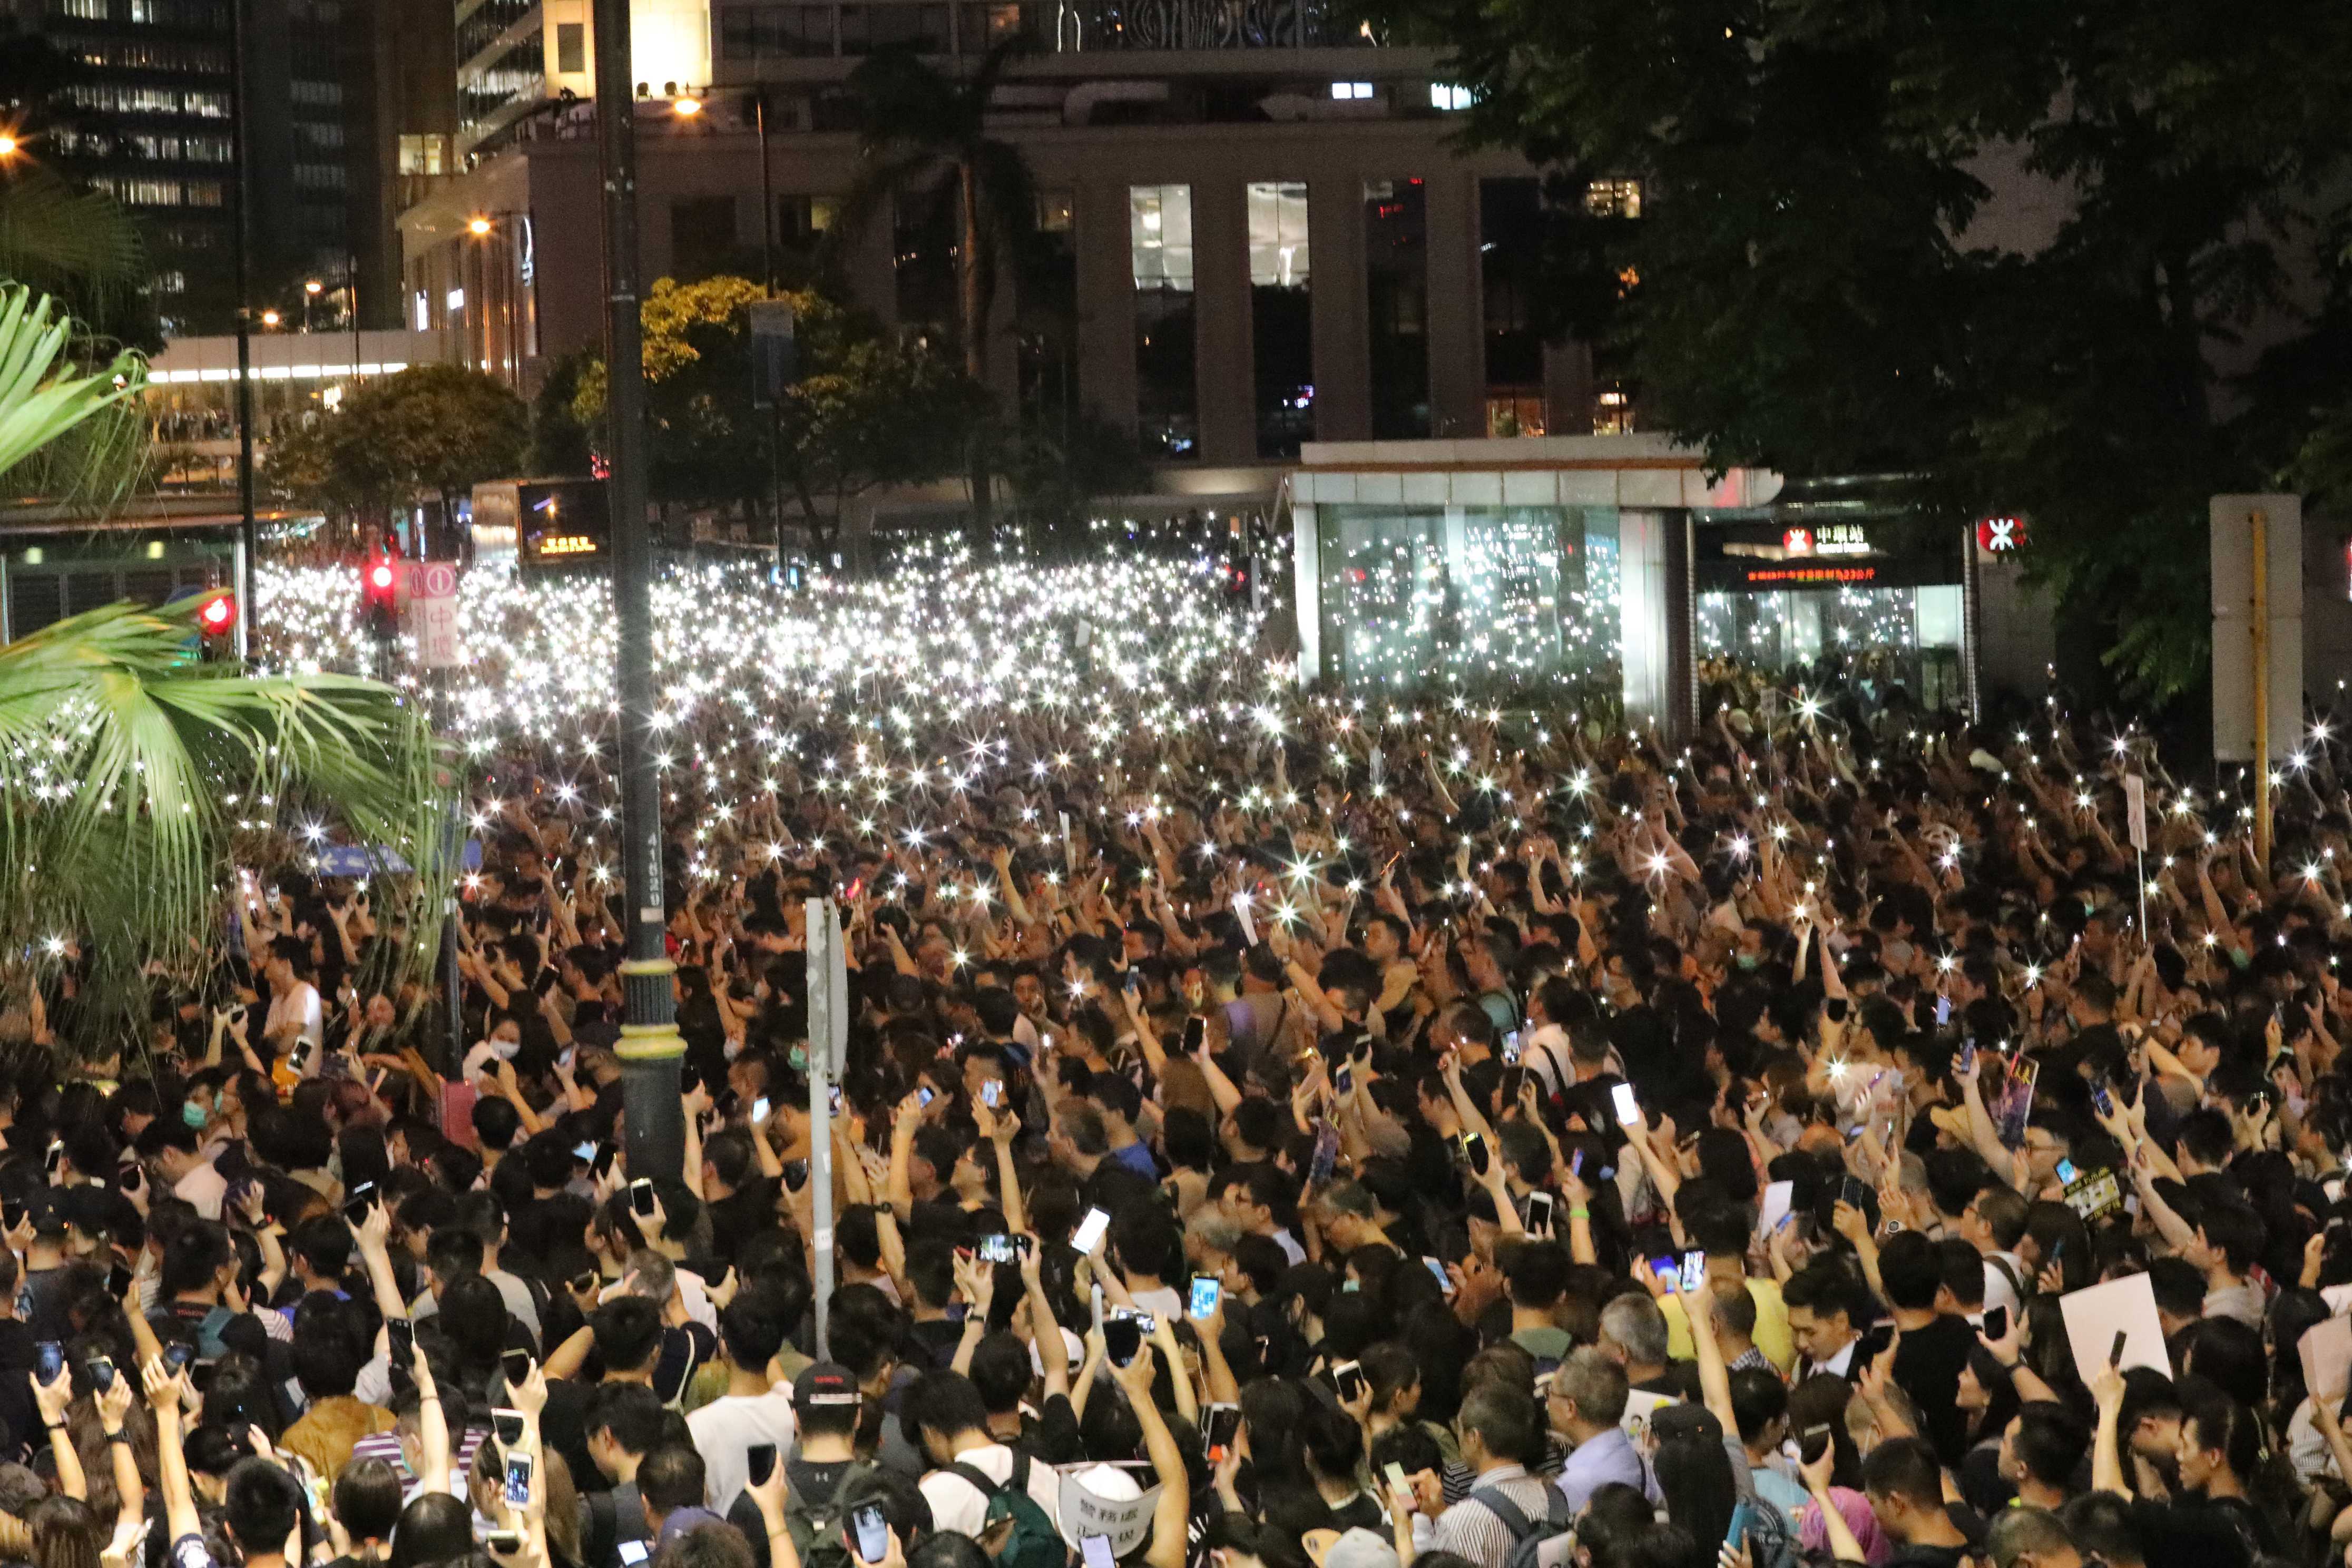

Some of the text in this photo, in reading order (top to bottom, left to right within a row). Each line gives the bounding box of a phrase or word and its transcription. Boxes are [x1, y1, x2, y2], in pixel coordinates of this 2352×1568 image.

[1817, 524, 1864, 543] 中環站
[430, 605, 456, 659] 中環
